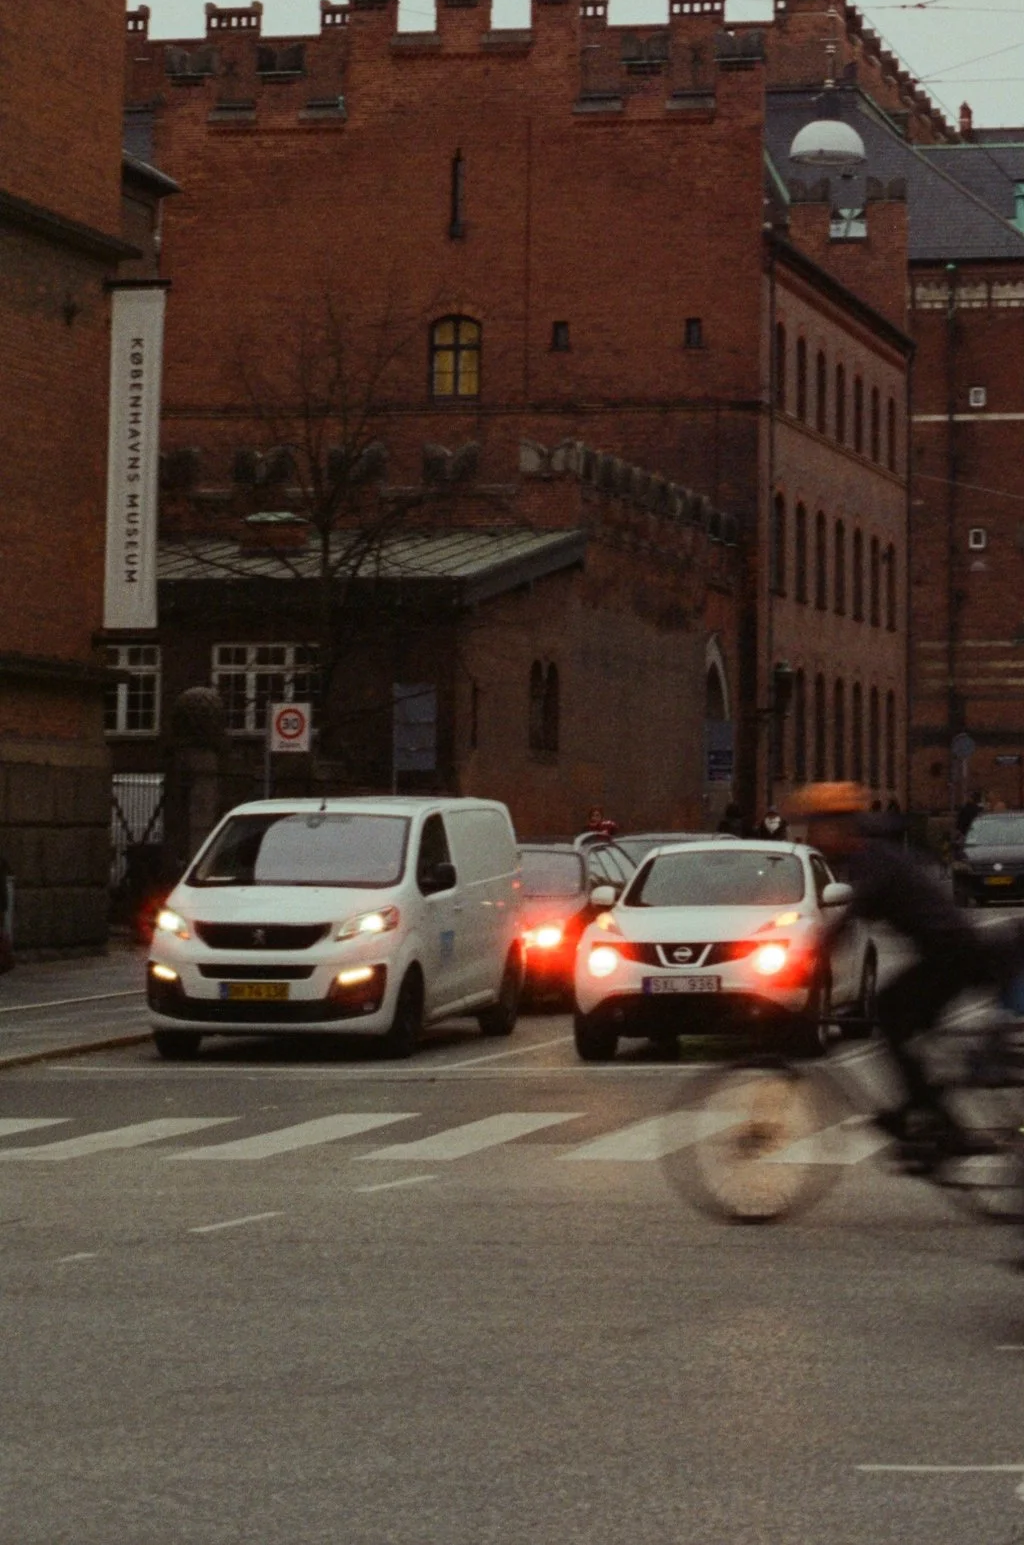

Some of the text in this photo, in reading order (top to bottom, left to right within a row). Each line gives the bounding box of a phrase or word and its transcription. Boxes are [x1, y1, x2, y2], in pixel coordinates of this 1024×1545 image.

[123, 337, 144, 584] KØBENHAVNS MUSEUM
[281, 717, 299, 730] 30
